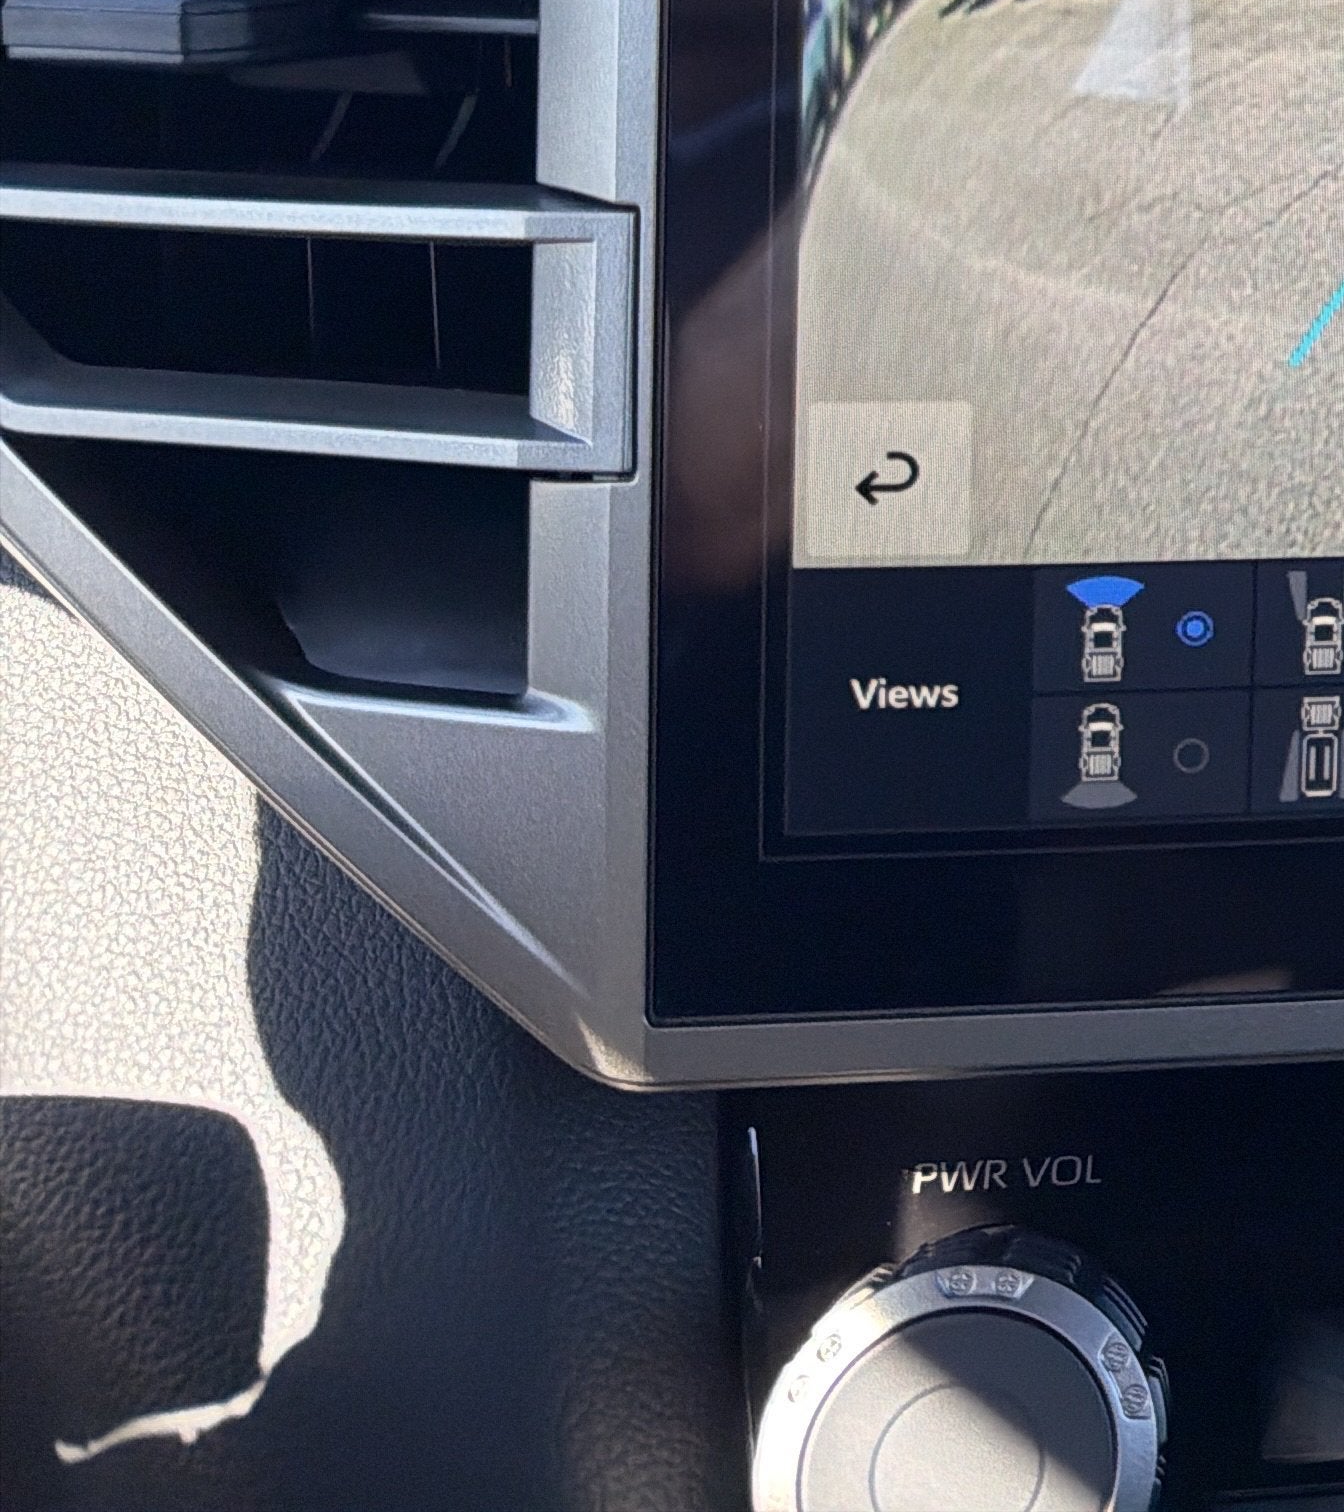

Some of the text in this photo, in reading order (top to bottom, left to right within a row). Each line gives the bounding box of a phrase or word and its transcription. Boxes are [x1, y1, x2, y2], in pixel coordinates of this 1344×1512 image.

[850, 677, 960, 710] Views
[911, 1154, 1103, 1195] PWR VOL
